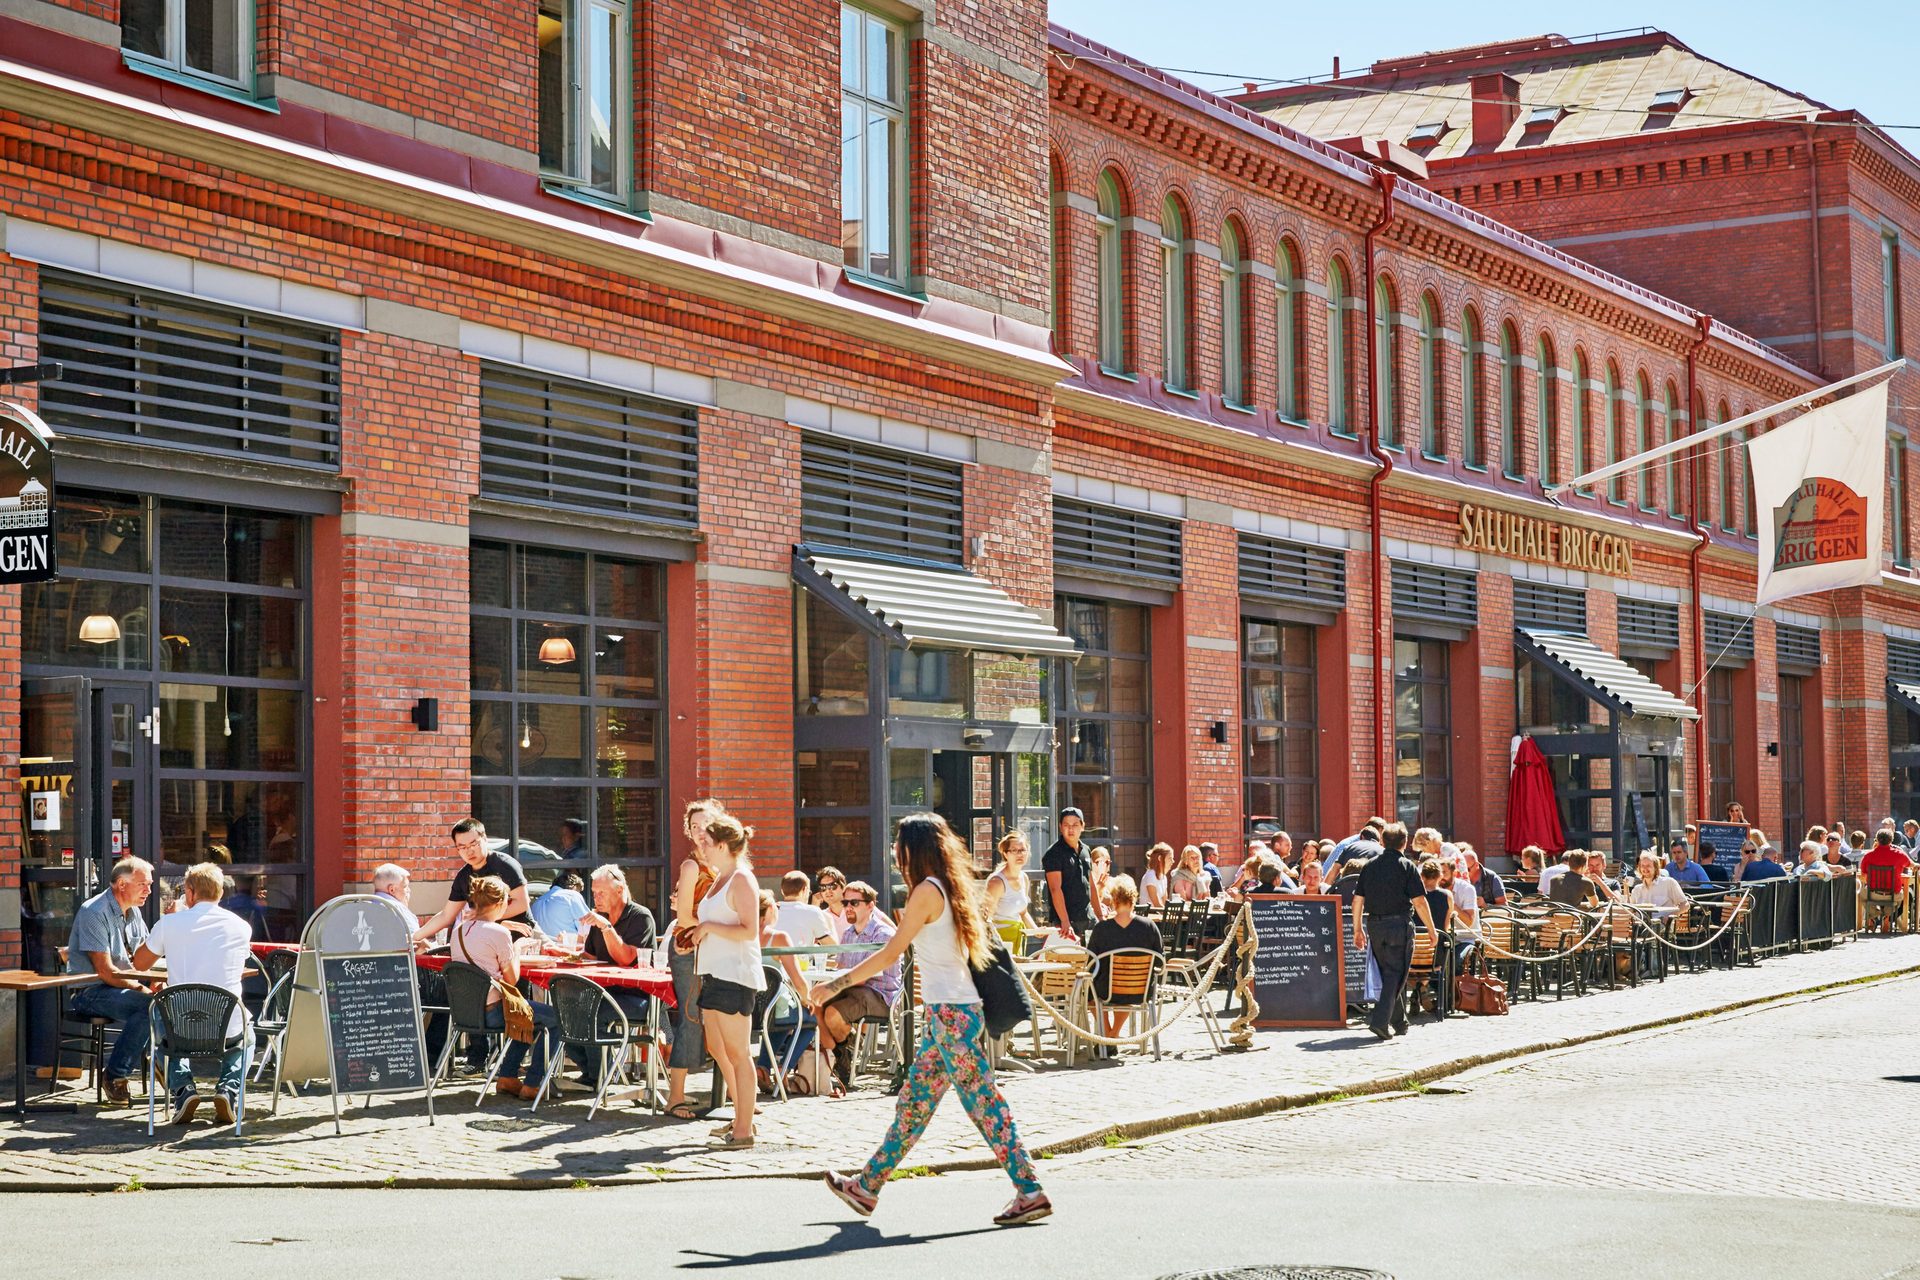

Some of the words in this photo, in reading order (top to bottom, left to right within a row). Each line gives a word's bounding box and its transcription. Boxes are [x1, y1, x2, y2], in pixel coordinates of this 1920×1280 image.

[1790, 483, 1849, 513] LUHALL
[1461, 503, 1555, 562] SALUHALL
[1560, 524, 1633, 576] BRIGGEN
